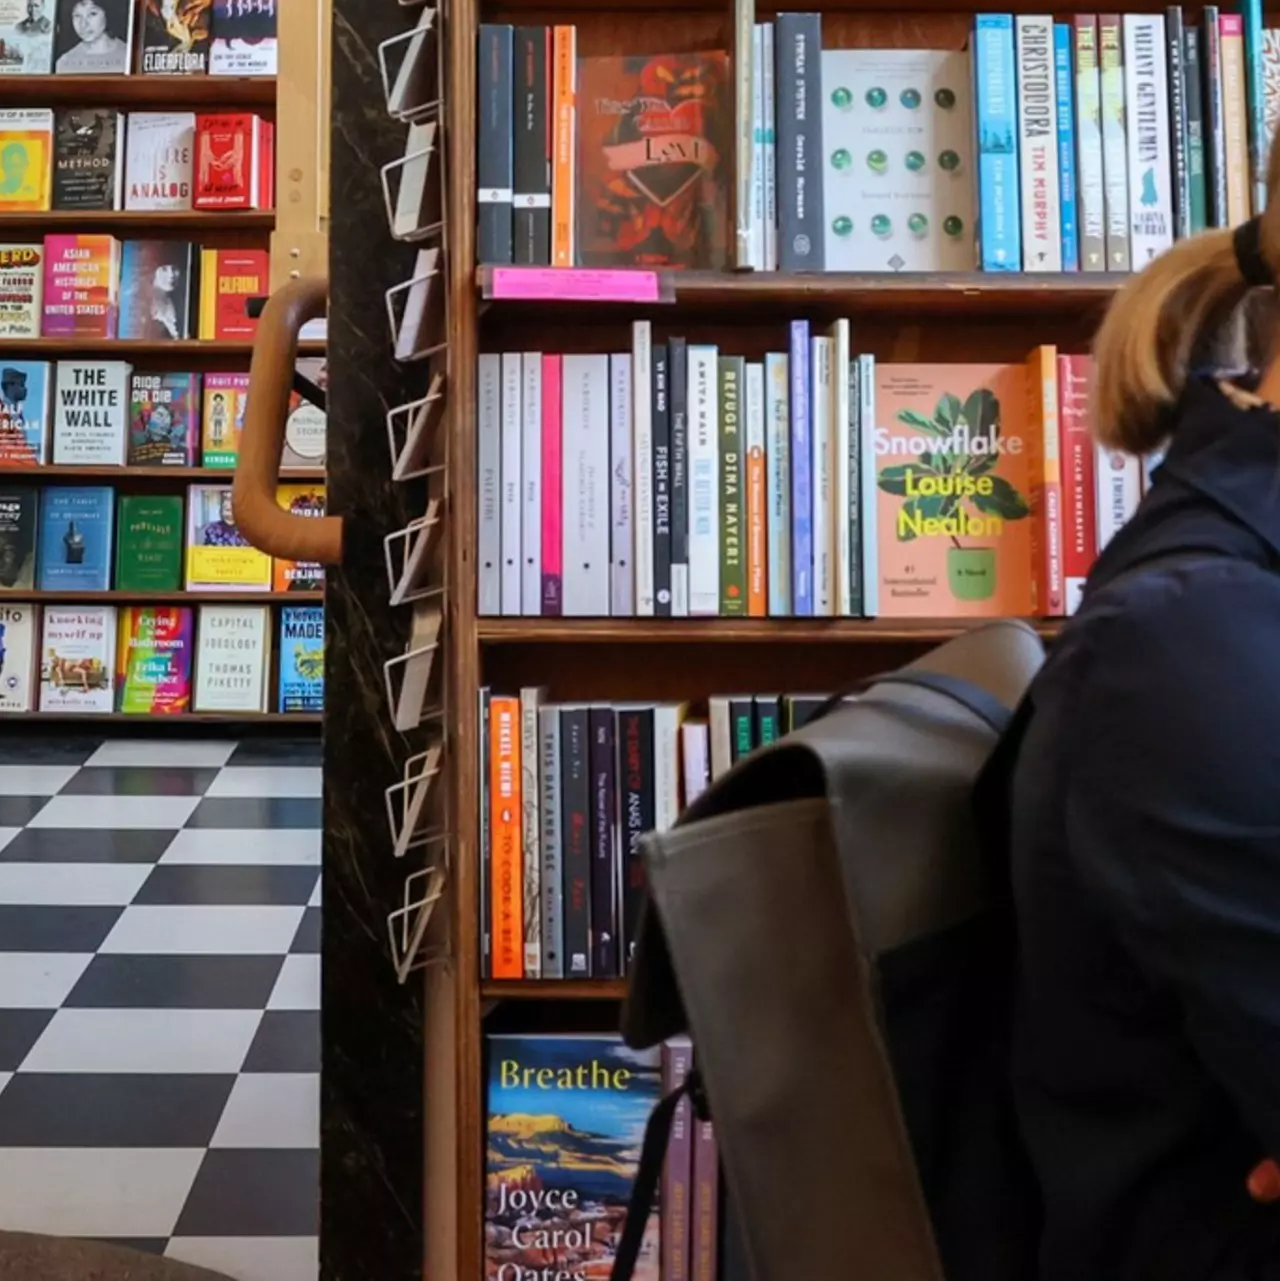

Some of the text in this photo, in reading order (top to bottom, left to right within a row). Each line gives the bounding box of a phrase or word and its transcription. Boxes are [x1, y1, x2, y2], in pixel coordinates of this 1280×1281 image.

[144, 52, 205, 71] ELDERFLORA
[1021, 24, 1050, 241] CHRISTODORA TIM MURPHY
[58, 159, 110, 169] METHOD
[131, 183, 189, 198] ANALOG
[63, 249, 90, 259] ASIAN
[53, 263, 99, 273] AMERICAN
[54, 277, 97, 287] HISTORIES
[62, 291, 88, 300] OF THE
[45, 304, 105, 315] UNITED STATES
[72, 368, 107, 386] THE
[61, 389, 118, 407] WHITE
[65, 410, 112, 427] WALL
[874, 424, 1023, 455] Snowflake
[724, 371, 738, 566] REFUGE DINA NAYERI
[904, 469, 995, 496] Louise
[897, 508, 1003, 536] Nealon
[48, 615, 103, 627] knocking
[138, 615, 176, 628] Crying
[210, 618, 254, 629] CAPITAL
[48, 630, 104, 641] myself up
[284, 623, 323, 639] MADE
[129, 639, 184, 649] Bathroom
[205, 639, 256, 650] IDEOLOGY
[209, 664, 251, 674] THOMAS
[207, 677, 251, 688] PIKETTY
[544, 733, 555, 872] THIS DAY AND AGE
[500, 1060, 631, 1090] Breathe
[498, 1183, 578, 1215] Joyce
[511, 1221, 592, 1250] Carol
[498, 1262, 587, 1281] Oates
